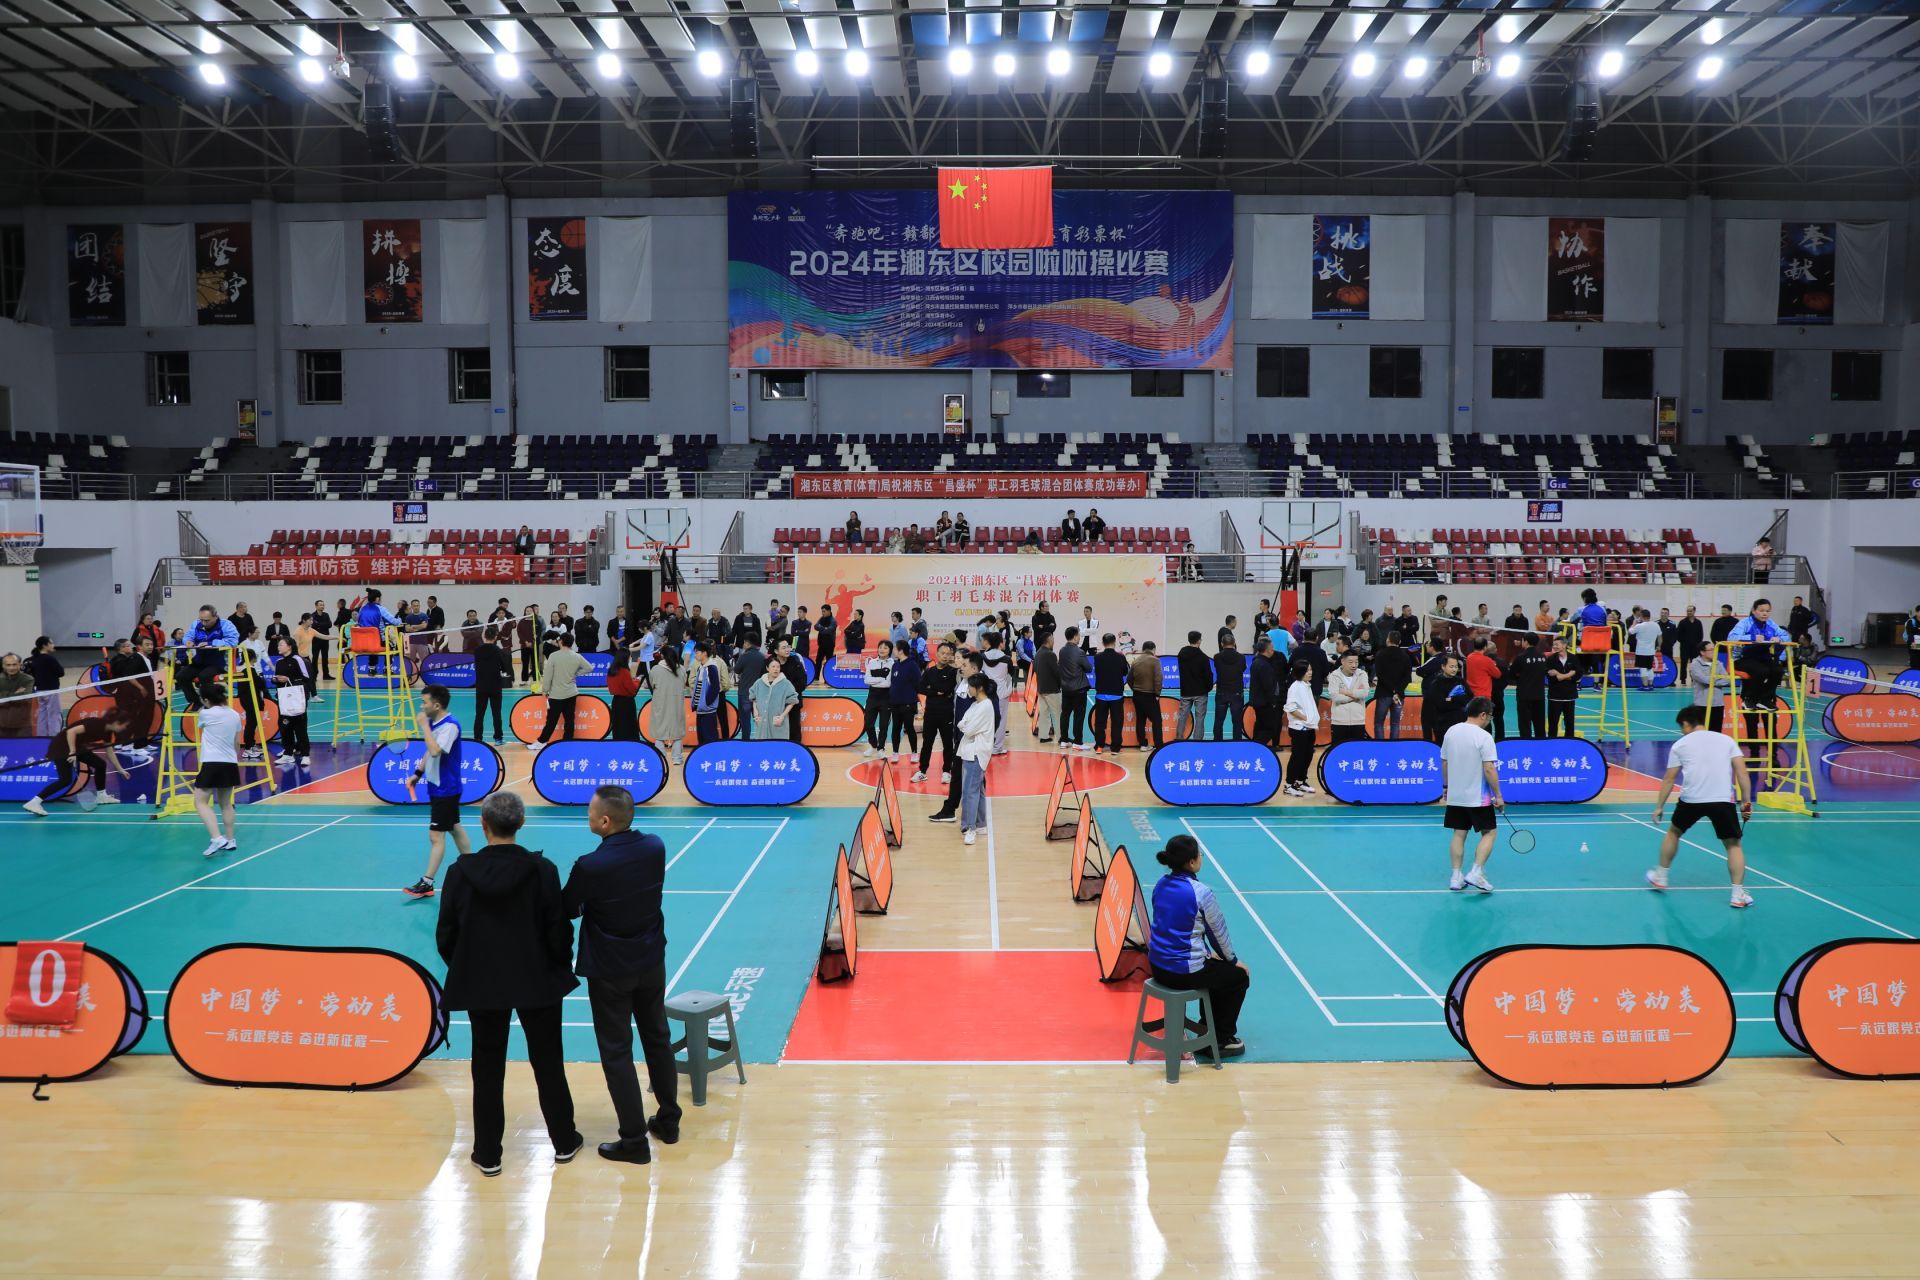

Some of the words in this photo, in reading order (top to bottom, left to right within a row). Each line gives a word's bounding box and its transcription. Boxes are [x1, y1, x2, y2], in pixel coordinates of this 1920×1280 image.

[1052, 223, 1134, 243] 育彩票杯”
[371, 230, 410, 285] 拼搏
[534, 228, 580, 296] 态度
[789, 249, 1169, 276] 2024年湘东区校园啦啦操比赛
[1319, 223, 1365, 283] 挑战
[1559, 230, 1597, 298] 协作
[1784, 224, 1833, 280] 奉献
[74, 233, 113, 304] 团结
[1557, 262, 1591, 276] BASKETBALL
[218, 558, 359, 577] 强根固基抓防范
[371, 558, 515, 576] 维护治安保平安
[916, 589, 1080, 604] 职工羽毛球混合团体赛
[156, 680, 164, 696] 3
[1809, 679, 1816, 694] 1
[28, 949, 67, 1007] 0
[200, 988, 402, 1022] 中国梦·劳动美
[1493, 985, 1702, 1016] 中国梦·劳动美
[1826, 979, 1908, 1008] 中国梦
[226, 1028, 294, 1045] 永远跟党走
[299, 1031, 368, 1049] 奋进新征程
[1527, 1030, 1597, 1045] 永远跟党走
[1602, 1029, 1672, 1044] 奋进新征程
